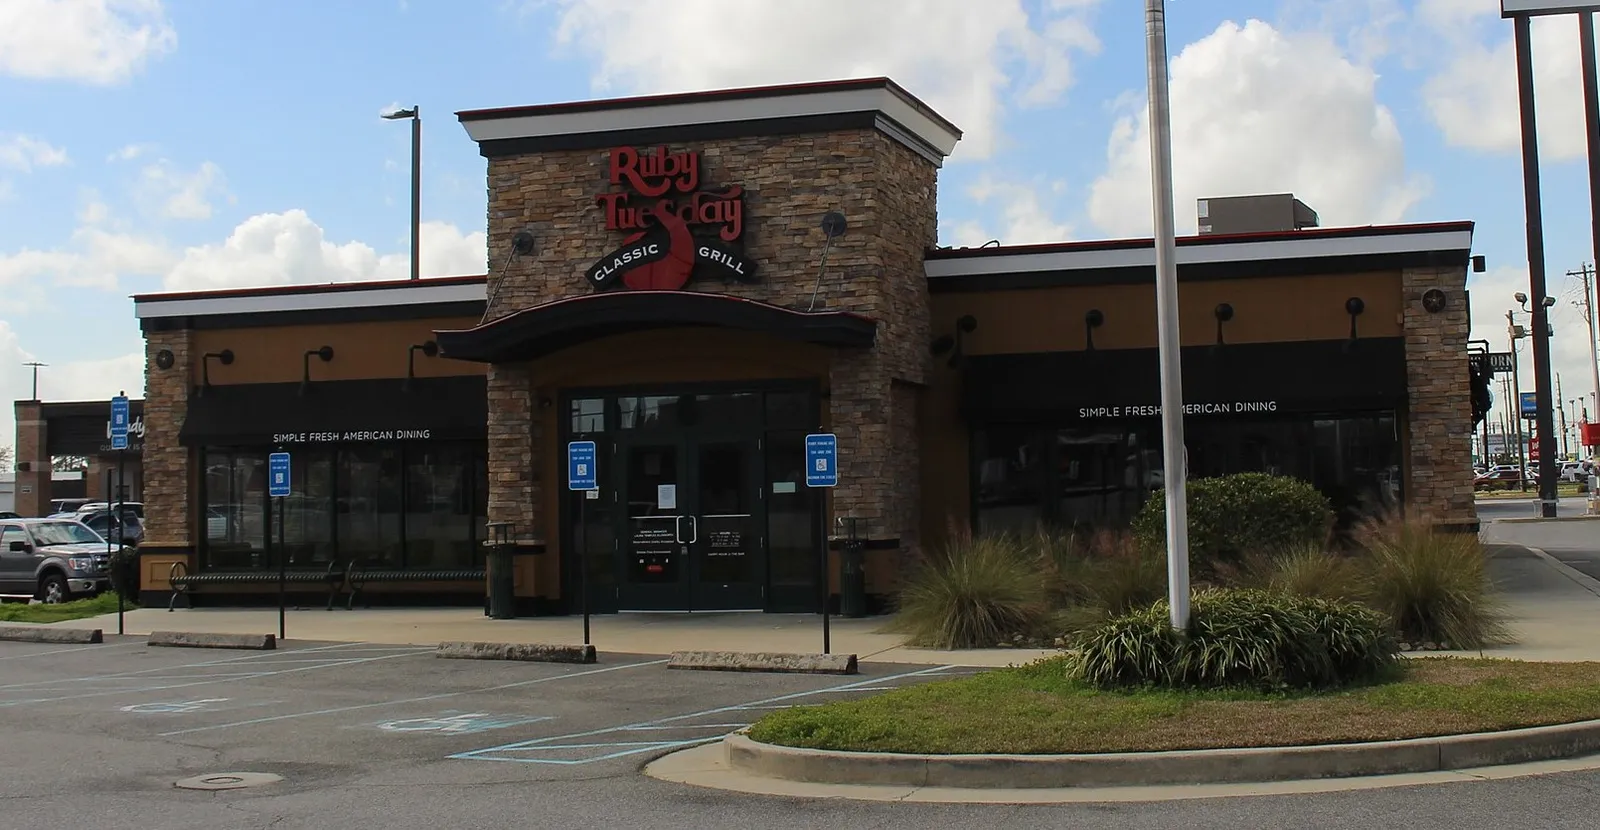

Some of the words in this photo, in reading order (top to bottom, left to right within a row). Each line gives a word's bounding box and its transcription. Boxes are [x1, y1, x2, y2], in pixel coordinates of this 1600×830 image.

[609, 144, 698, 197] Ruby
[594, 184, 744, 241] Tuesday
[594, 244, 659, 281] CLASSIC
[699, 246, 744, 275] GRILL
[1079, 406, 1120, 418] SIMPLE
[1125, 405, 1162, 416] FRESH
[1181, 403, 1230, 414] ERICAN
[1235, 401, 1277, 412] DINING
[273, 432, 306, 443] SIMPLE
[309, 431, 339, 442] FRESH
[343, 430, 393, 441] AMERICAN
[396, 429, 431, 439] DINING
